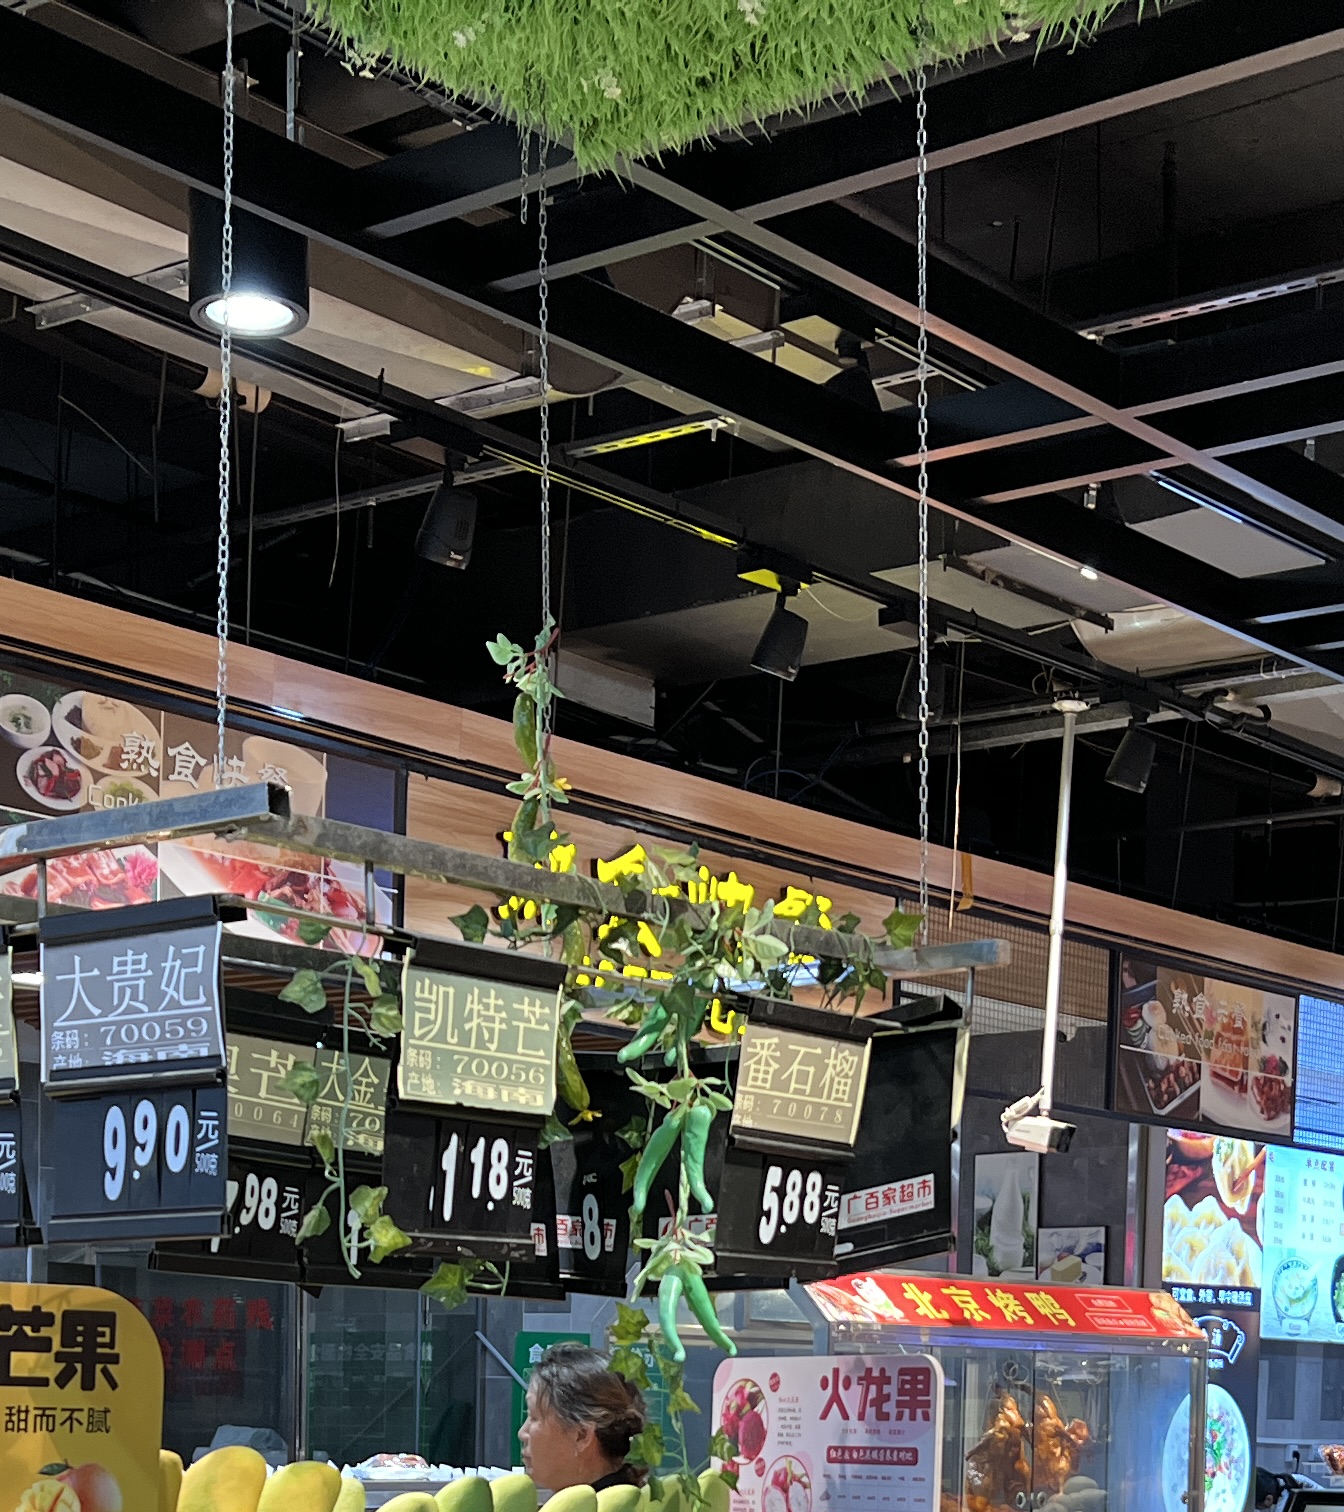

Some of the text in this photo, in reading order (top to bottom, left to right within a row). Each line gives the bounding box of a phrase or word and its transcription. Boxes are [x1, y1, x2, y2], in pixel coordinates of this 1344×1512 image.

[56, 944, 207, 1024] 大贵妃
[100, 1016, 208, 1046] 70059
[414, 977, 551, 1056] 凯特芒
[319, 1050, 388, 1109] 大金
[453, 1055, 545, 1085] 70056
[743, 1036, 859, 1102] 番石榴
[772, 1099, 844, 1124] 70078
[759, 1165, 823, 1245] 5.88
[847, 1178, 933, 1215] 广百家超市
[903, 1281, 1077, 1328] 北京烤鸭
[4, 1405, 112, 1434] 甜而不腻
[819, 1366, 932, 1422] 火龙果
